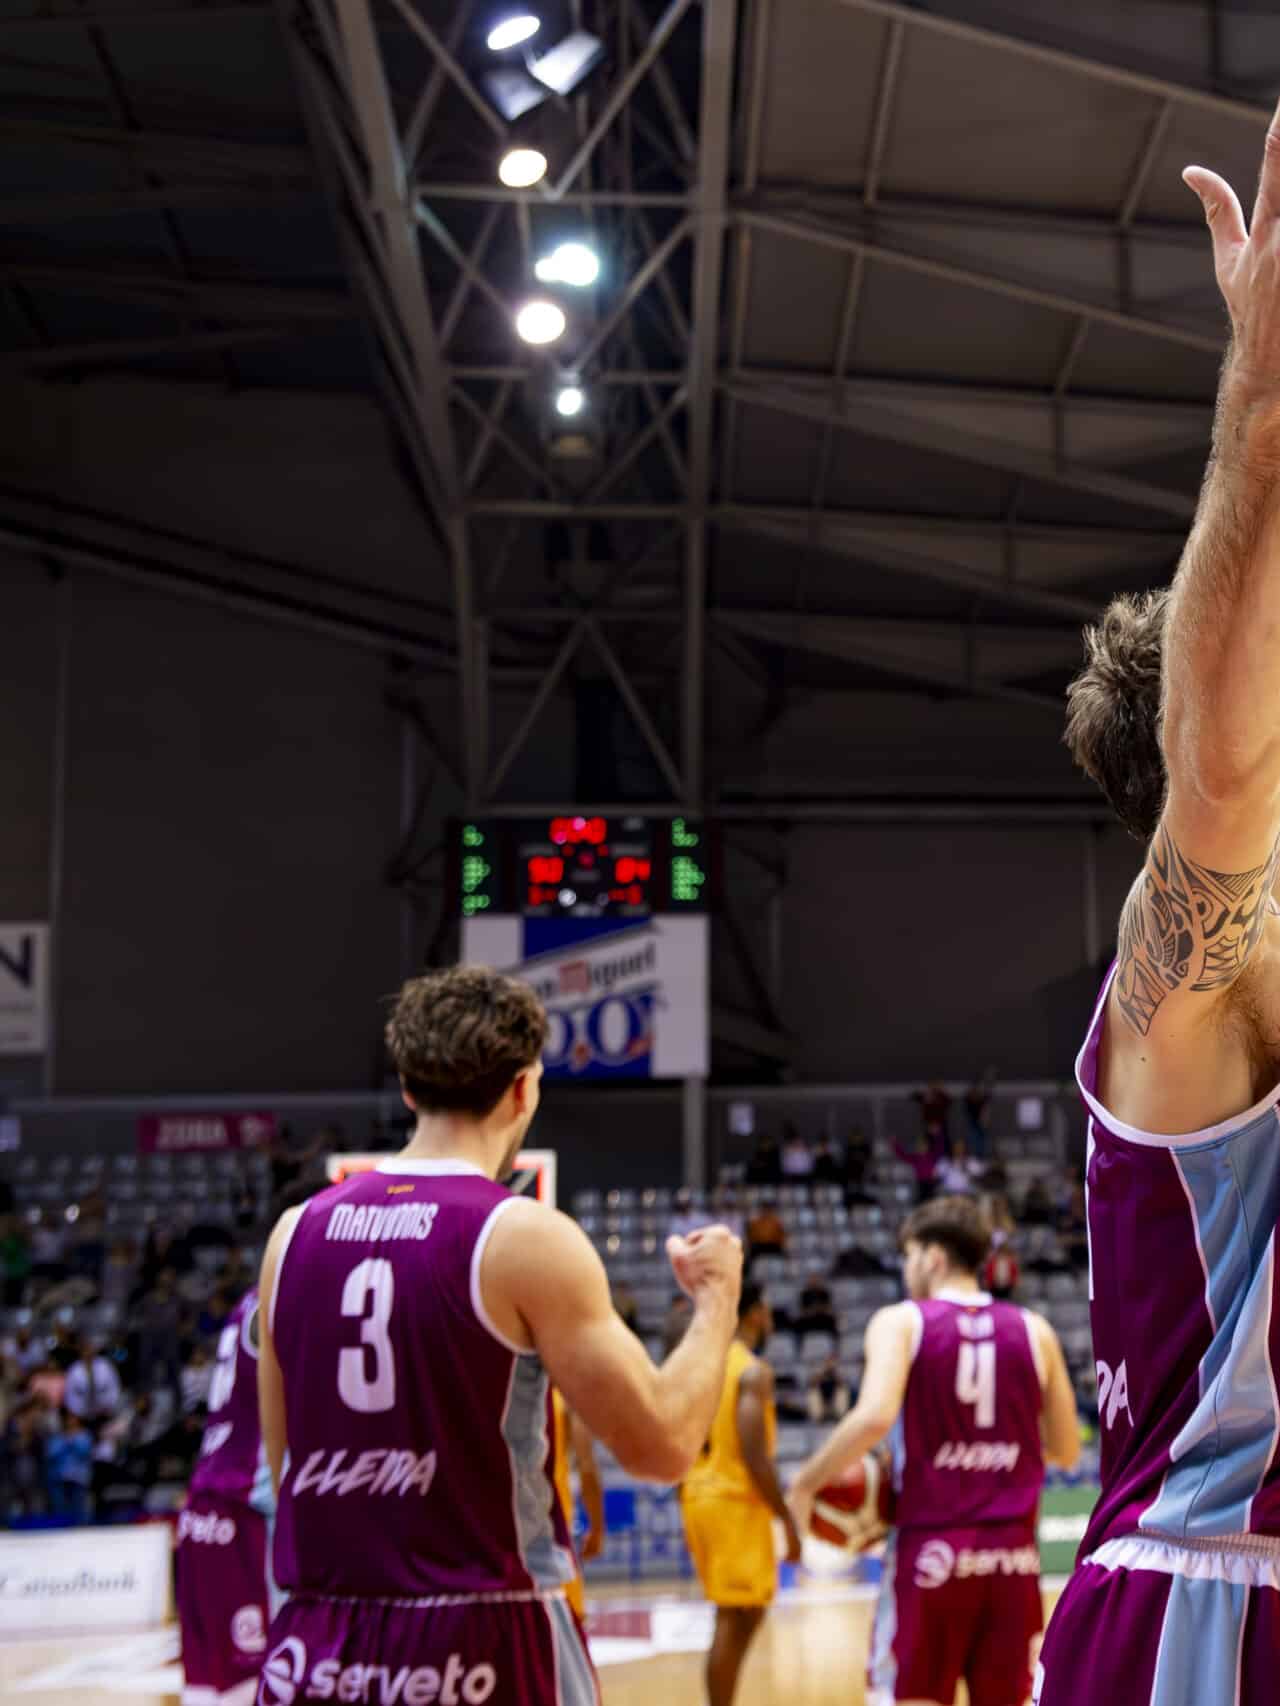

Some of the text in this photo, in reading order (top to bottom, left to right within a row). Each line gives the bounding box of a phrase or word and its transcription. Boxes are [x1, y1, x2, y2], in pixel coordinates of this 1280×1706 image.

[338, 1257, 395, 1413] 3
[956, 1340, 996, 1428] 4
[291, 1449, 437, 1497] LLEIDA
[304, 1653, 496, 1706] serveto
